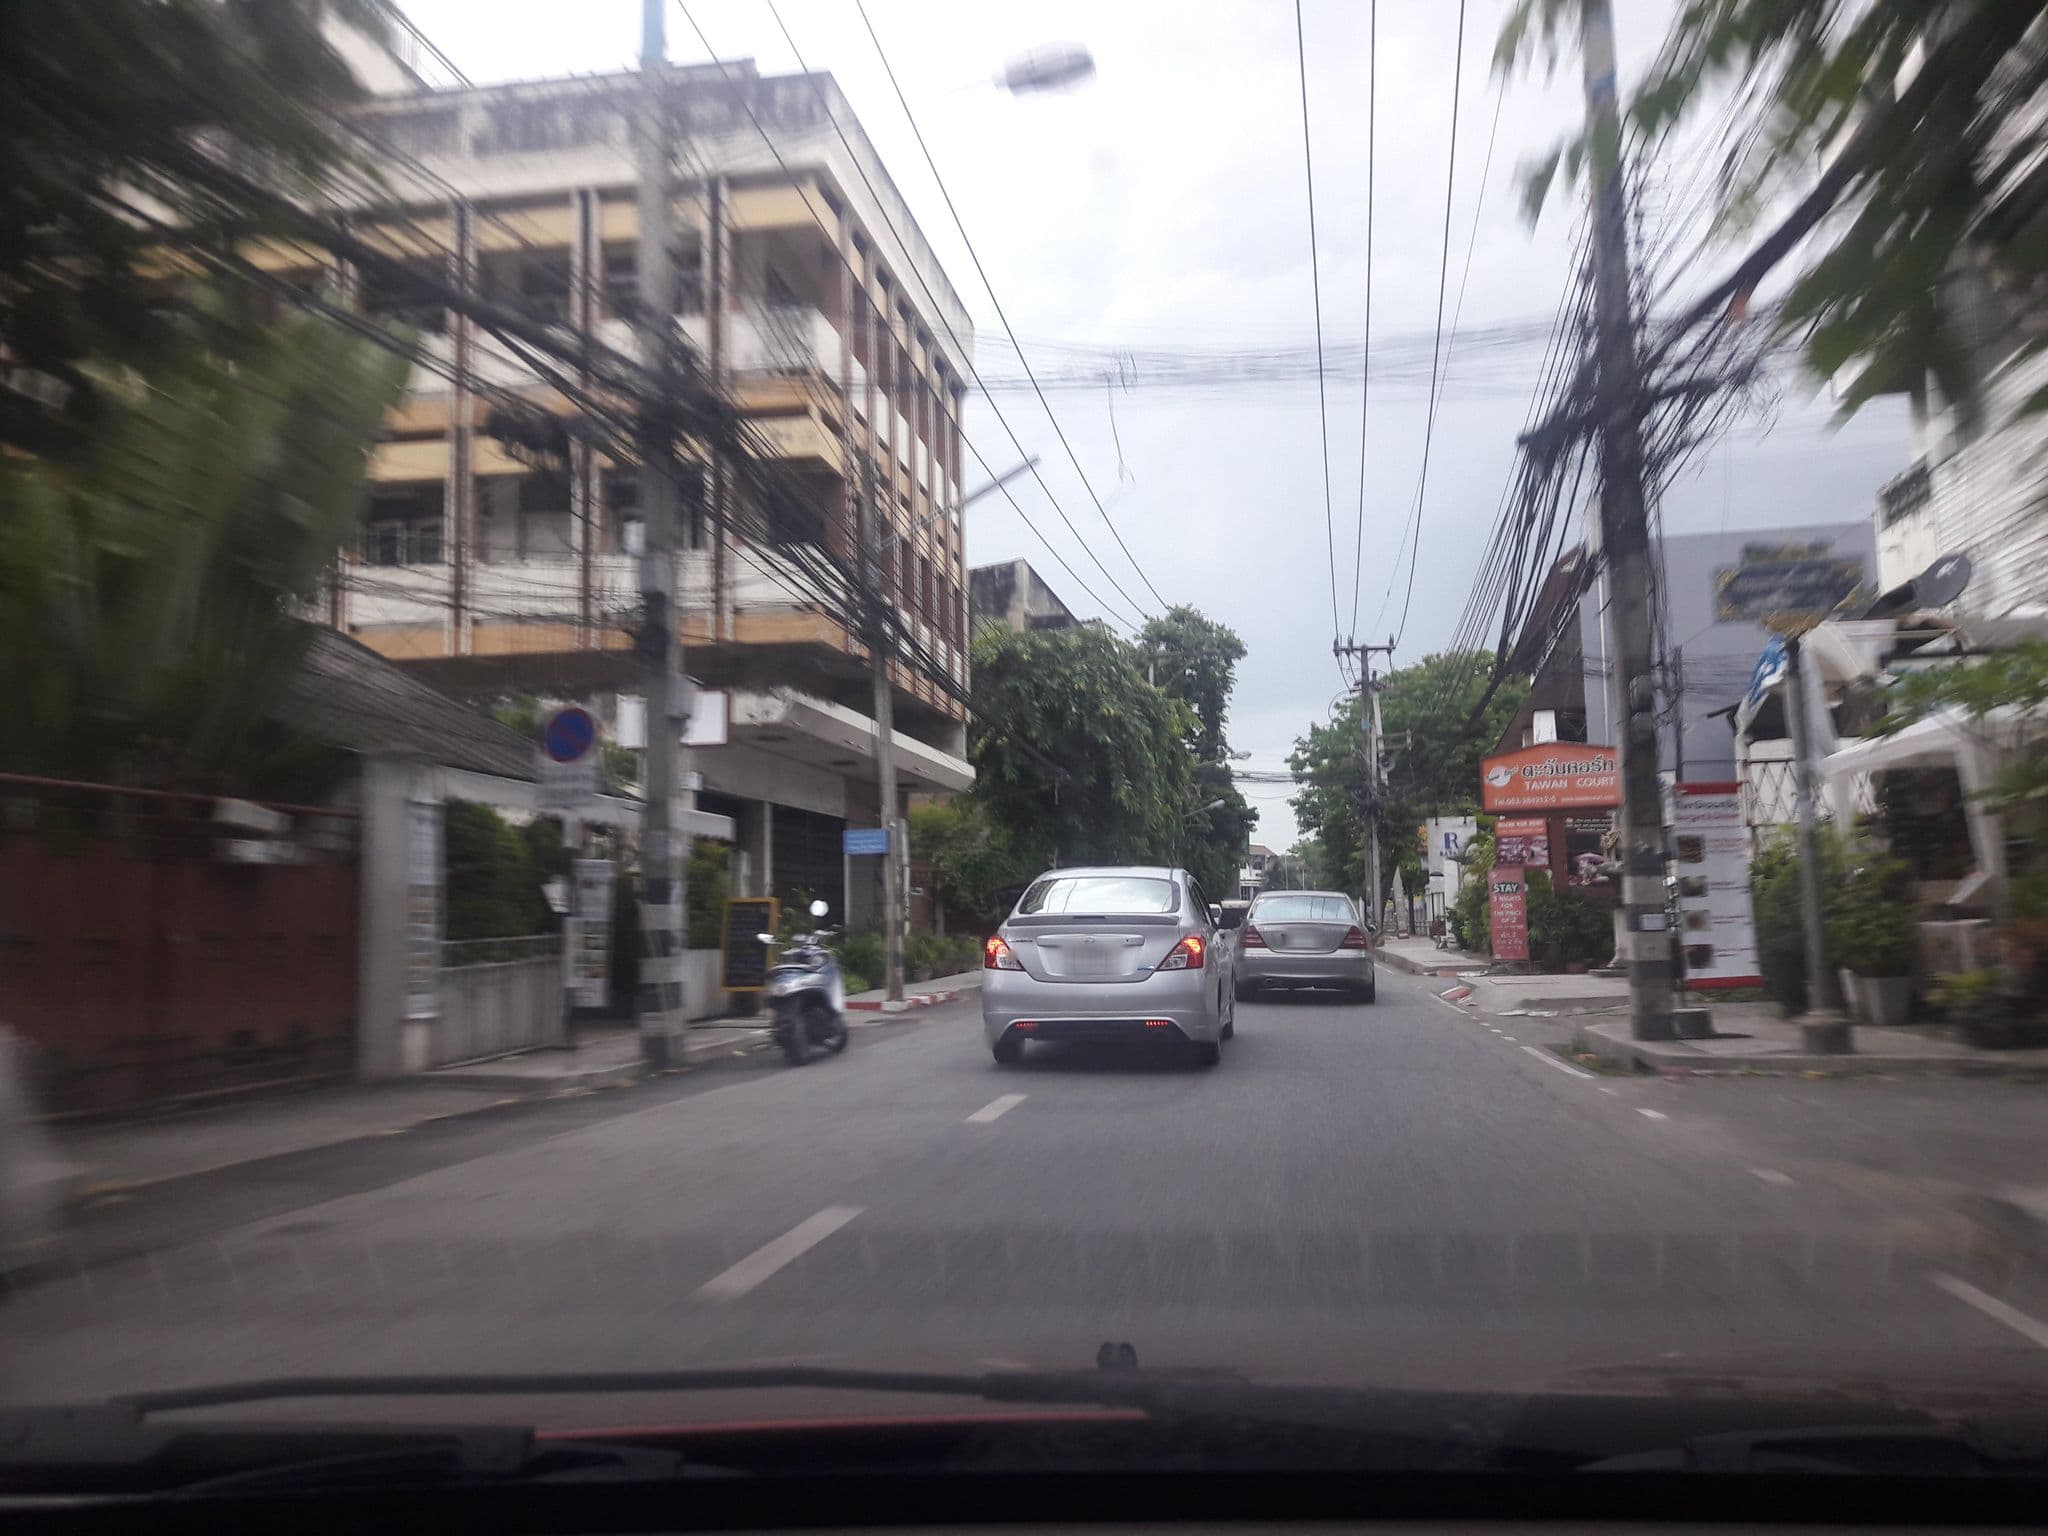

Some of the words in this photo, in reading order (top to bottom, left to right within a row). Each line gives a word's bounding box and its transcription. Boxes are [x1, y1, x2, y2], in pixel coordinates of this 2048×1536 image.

[1524, 780, 1568, 791] TAWAN
[1576, 777, 1615, 788] COURT
[1493, 883, 1519, 893] STAY
